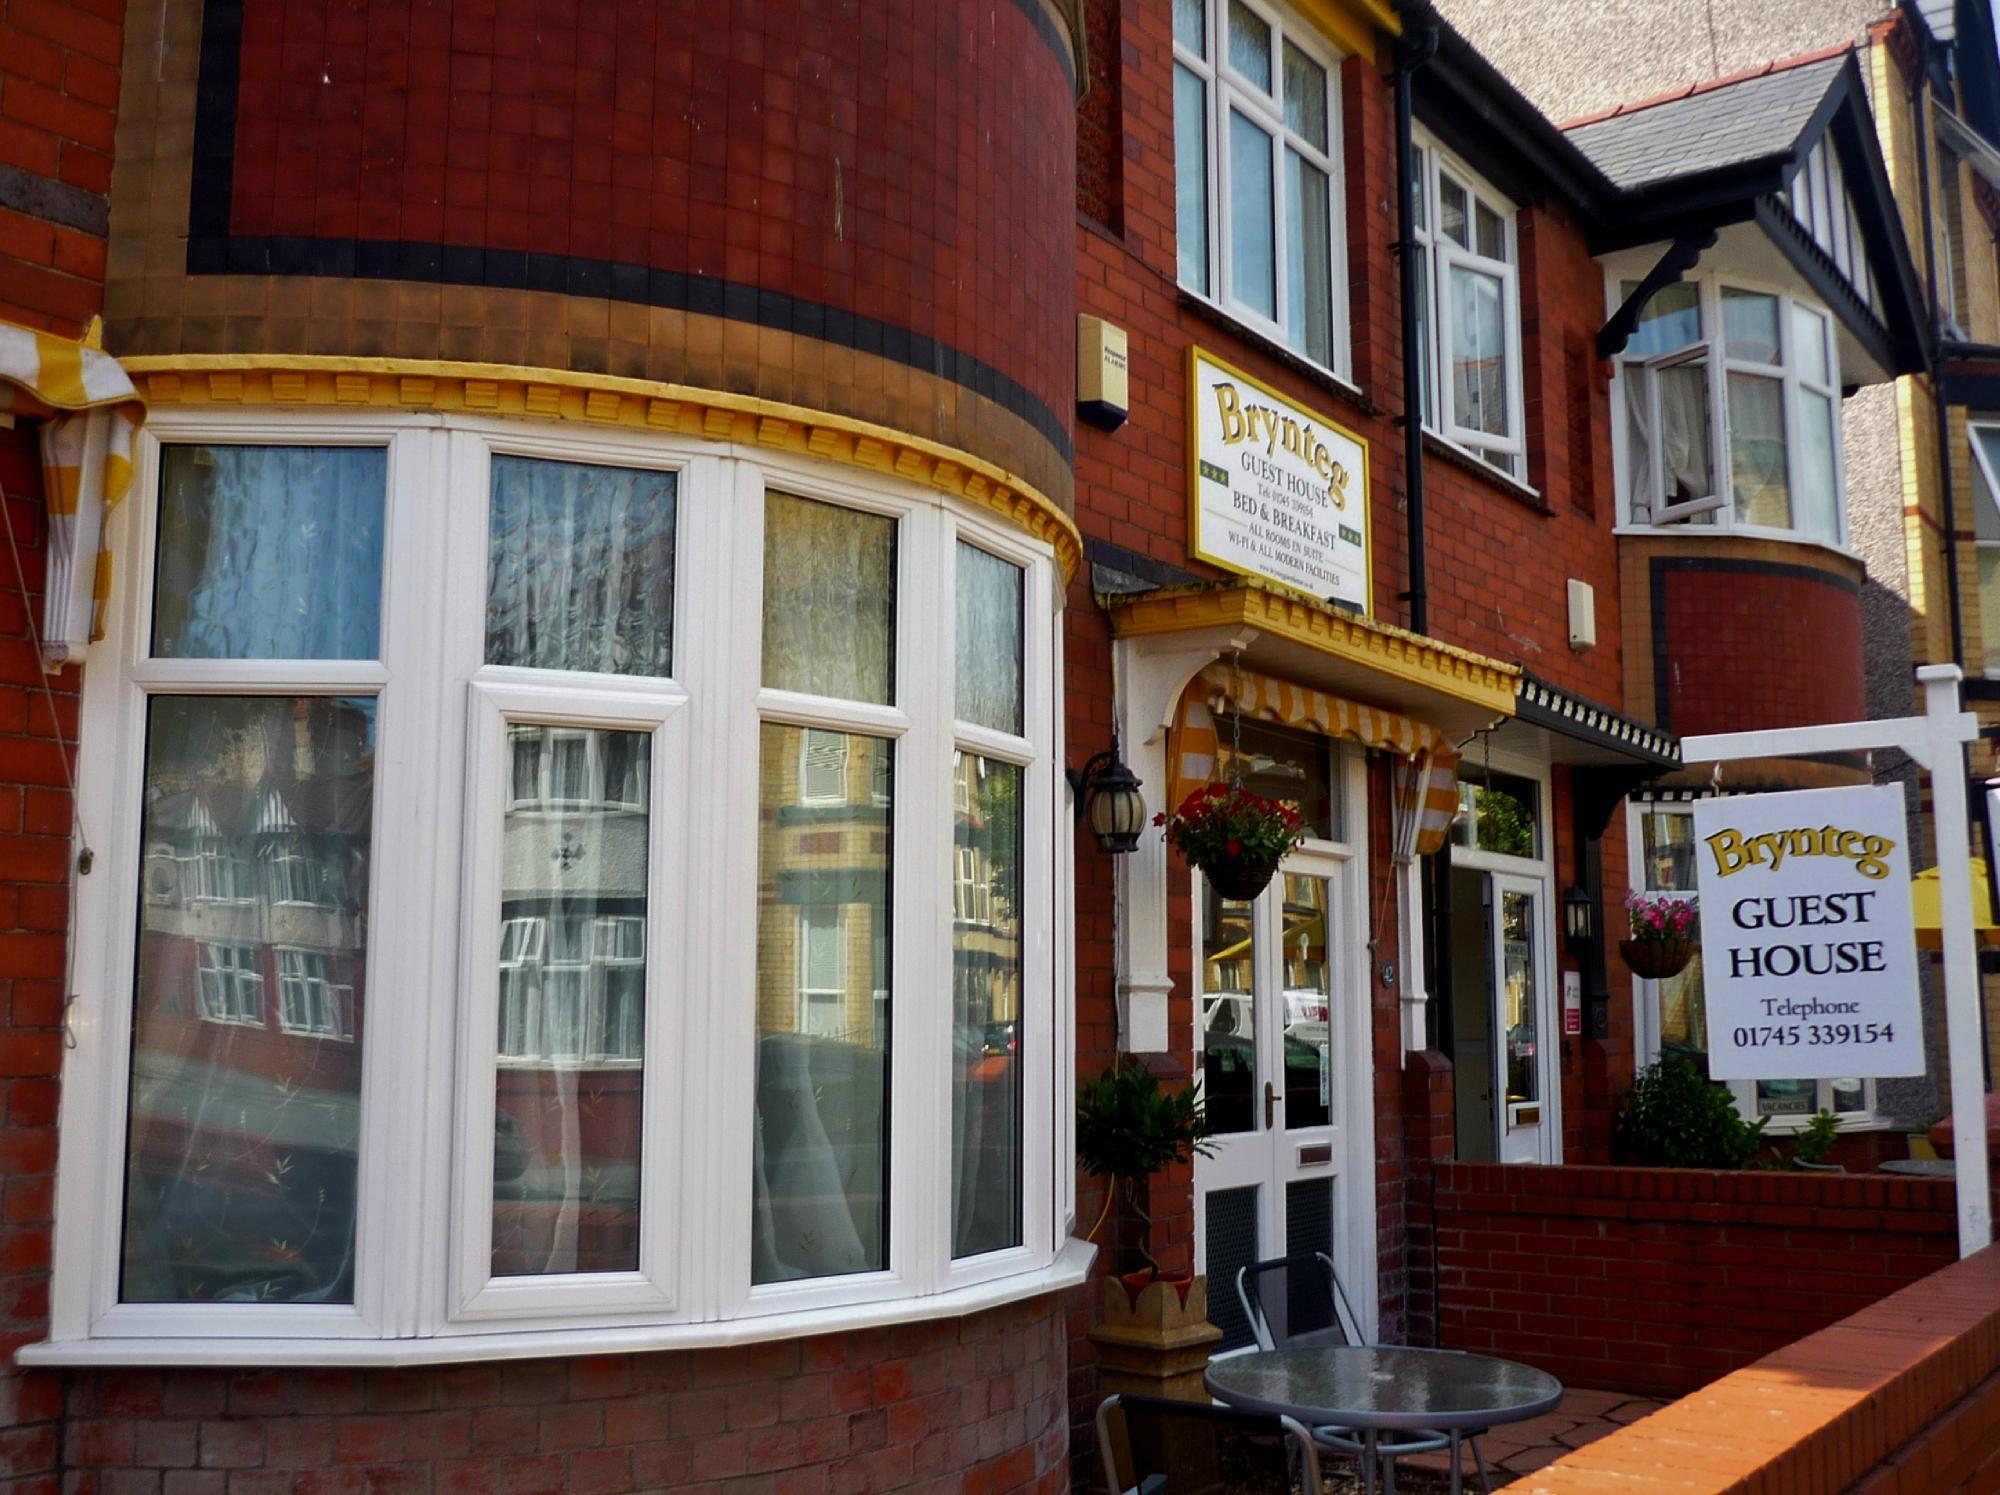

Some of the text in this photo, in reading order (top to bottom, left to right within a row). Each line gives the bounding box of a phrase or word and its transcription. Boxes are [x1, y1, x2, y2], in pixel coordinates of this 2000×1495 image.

[1212, 382, 1350, 512] Brynteg
[1241, 451, 1329, 508] GUEST HOUSE
[1233, 490, 1337, 551] BED & BREAKFAST
[1249, 522, 1324, 563] ALL ROOMS EN SUITE
[1228, 530, 1341, 587] WI-FI & ALL MODERN FACILITIES
[1704, 824, 1896, 880] Brynteg
[1732, 891, 1876, 930] GUEST
[1728, 941, 1887, 978] HOUSE
[1760, 998, 1860, 1020] Telephone
[1733, 1023, 1895, 1048] 01745 339154
